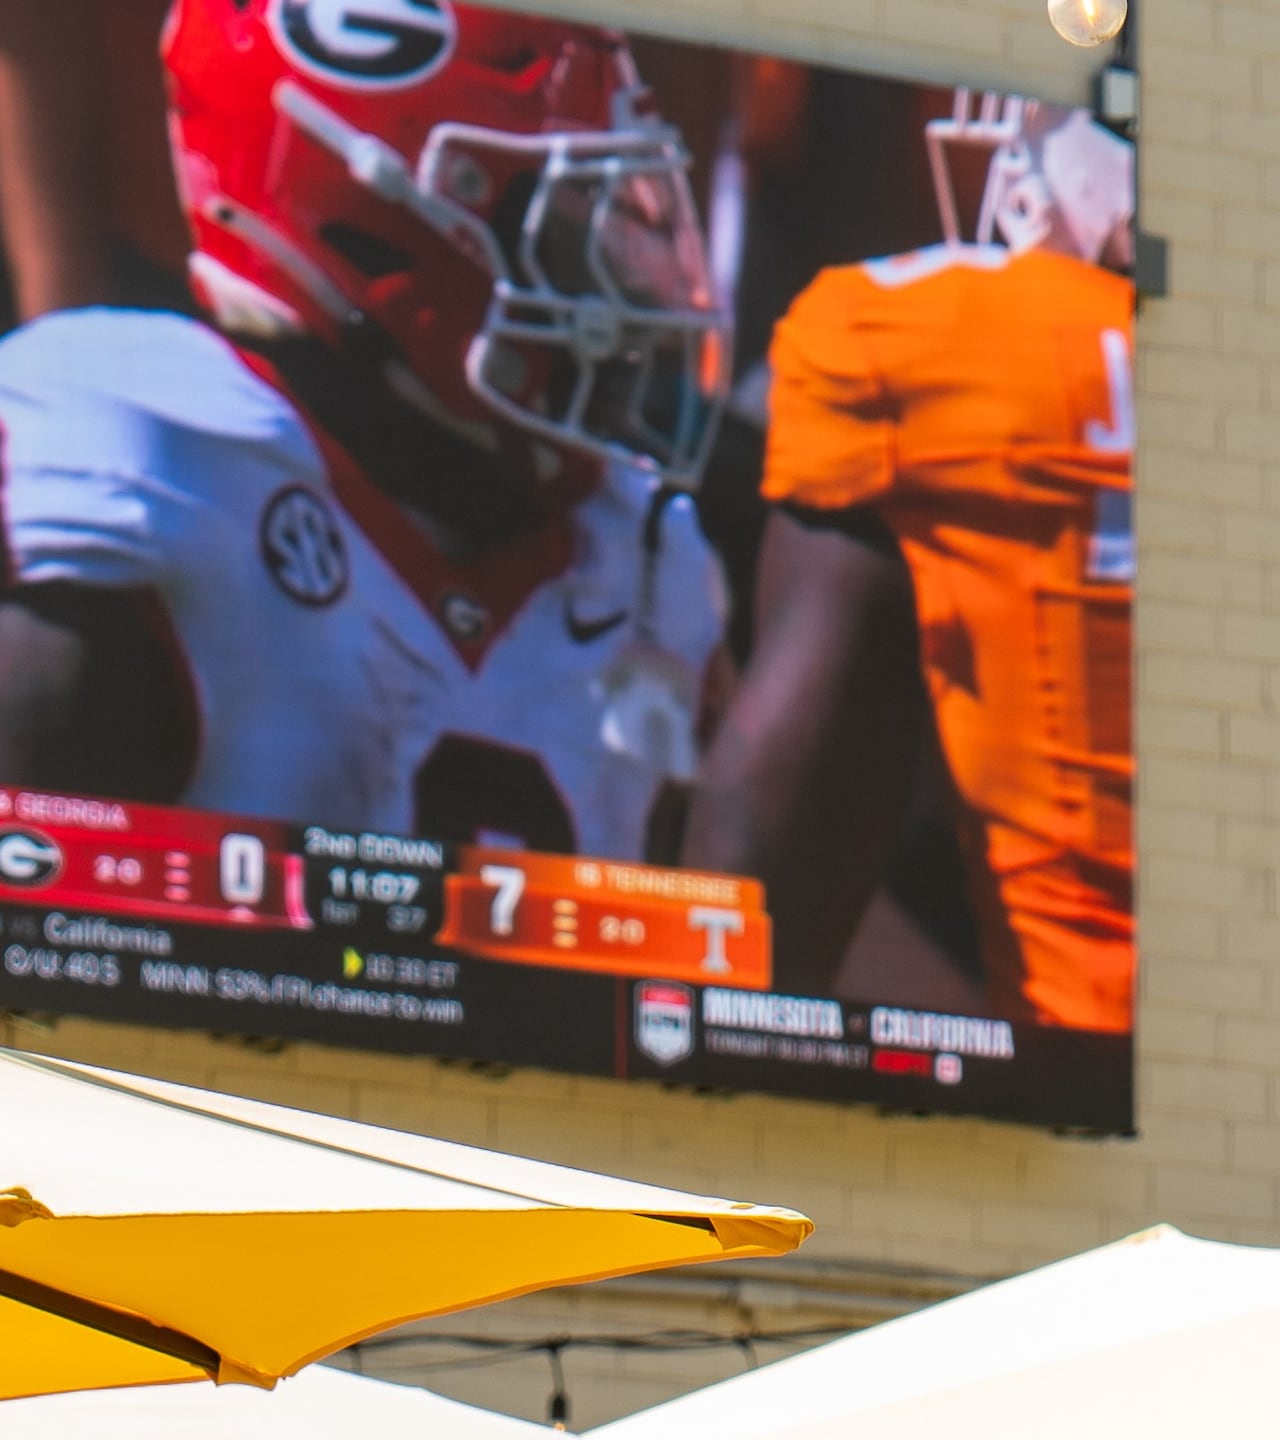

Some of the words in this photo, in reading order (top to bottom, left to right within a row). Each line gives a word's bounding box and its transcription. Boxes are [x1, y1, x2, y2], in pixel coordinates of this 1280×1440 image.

[14, 792, 131, 831] GEORGIA
[220, 832, 264, 904] 0
[358, 832, 443, 870] DOWN
[328, 865, 420, 904] 11:07
[479, 863, 526, 936] 7
[605, 864, 741, 906] TENNESSEE
[43, 911, 173, 956] California
[687, 905, 744, 975] T
[311, 982, 393, 1016] chance
[422, 998, 465, 1024] win
[702, 986, 845, 1040] MINNESOTA
[870, 1006, 1015, 1059] CALIFORNIA
